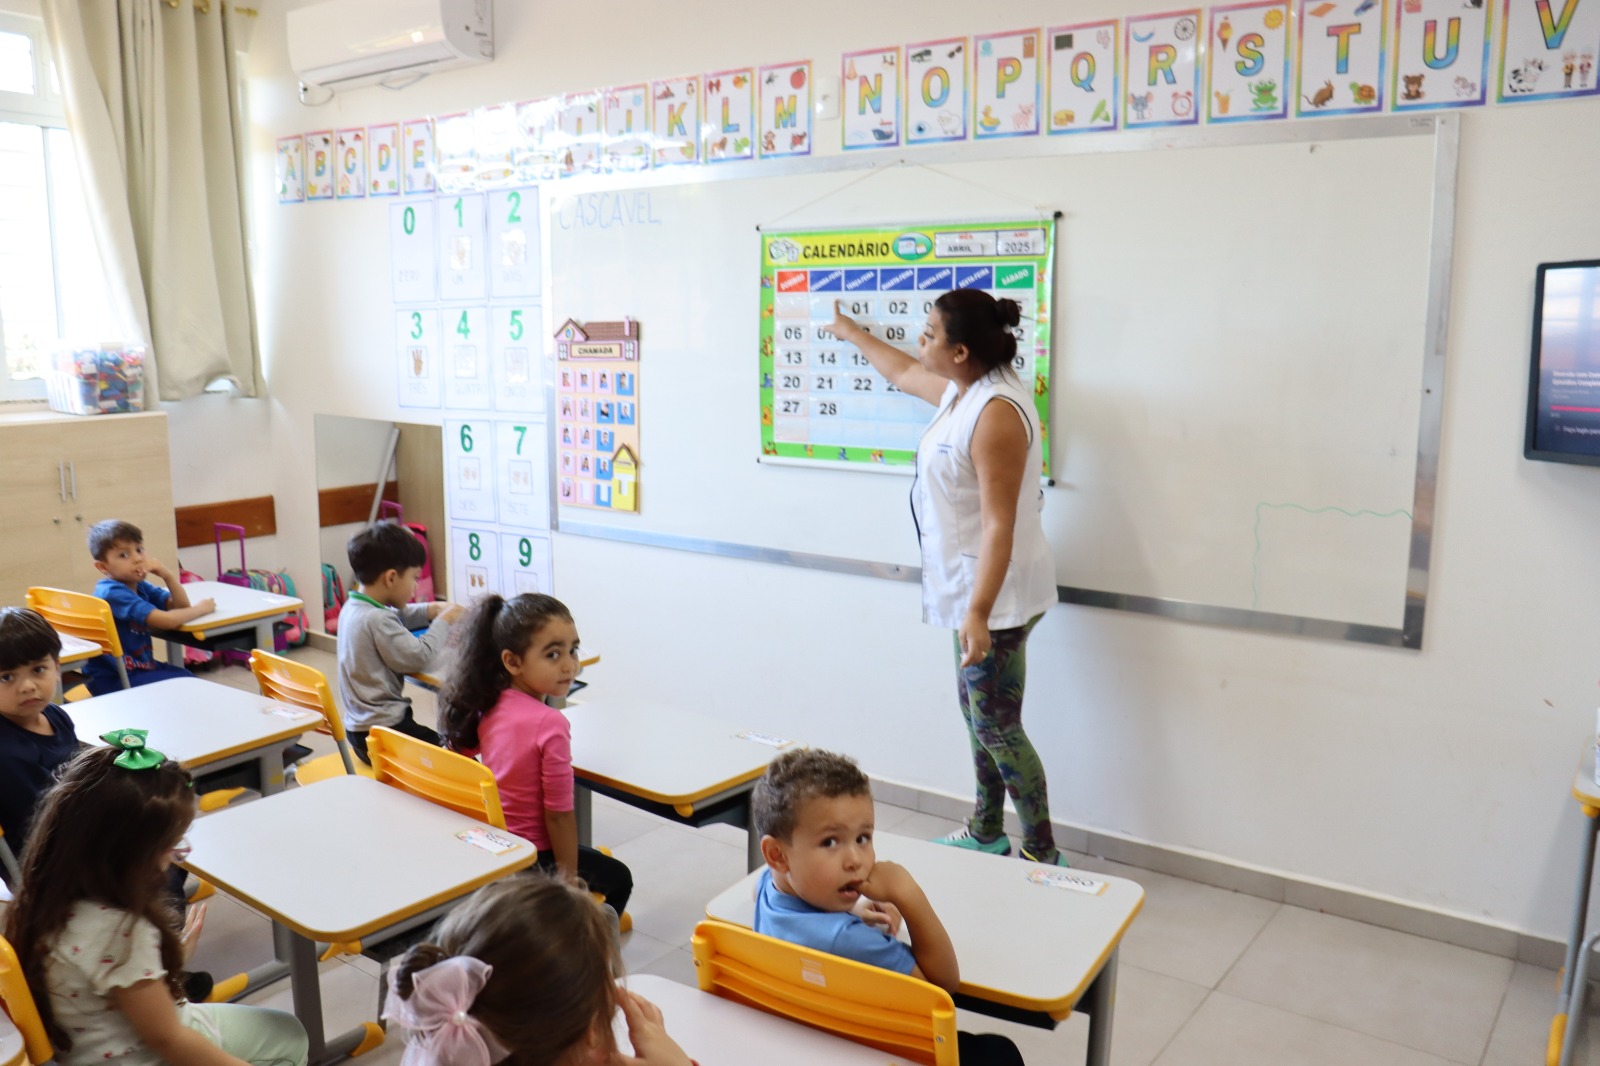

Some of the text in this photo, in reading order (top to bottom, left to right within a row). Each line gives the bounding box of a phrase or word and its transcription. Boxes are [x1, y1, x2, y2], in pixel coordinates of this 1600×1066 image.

[1535, 0, 1579, 50] V
[1234, 33, 1265, 77] S
[1326, 22, 1361, 74] T
[1423, 17, 1461, 69] U
[996, 57, 1022, 99] P
[1070, 52, 1096, 92] Q
[1148, 44, 1177, 86] R
[858, 73, 882, 115] N
[921, 66, 950, 108] O
[667, 102, 687, 137] K
[722, 96, 740, 133] L
[774, 94, 797, 129] M
[285, 154, 297, 180] A
[315, 151, 326, 177] B
[344, 148, 356, 175] C
[378, 144, 390, 172] D
[413, 140, 425, 168] E
[403, 207, 415, 235] 0
[454, 197, 463, 227] 1
[507, 192, 521, 223] 2
[558, 191, 662, 230] CASCAVEL
[803, 239, 889, 259] CALENDÁRIO
[947, 245, 972, 253] ABRIL
[1005, 241, 1030, 253] 2025
[852, 302, 869, 314] 01
[889, 302, 908, 314] 02
[411, 312, 423, 339] 3
[457, 310, 470, 339] 4
[510, 310, 524, 340] 5
[785, 328, 802, 340] 06
[886, 328, 905, 340] 09
[578, 346, 613, 355] CHAMADA
[785, 352, 802, 364] 13
[818, 352, 836, 365] 14
[852, 353, 869, 366] 15
[783, 376, 800, 388] 20
[817, 377, 833, 389] 21
[854, 378, 872, 391] 22
[783, 401, 837, 415] 27 28
[460, 424, 473, 452] 6
[513, 426, 527, 455] 7
[468, 533, 481, 561] 8
[518, 538, 532, 567] 9
